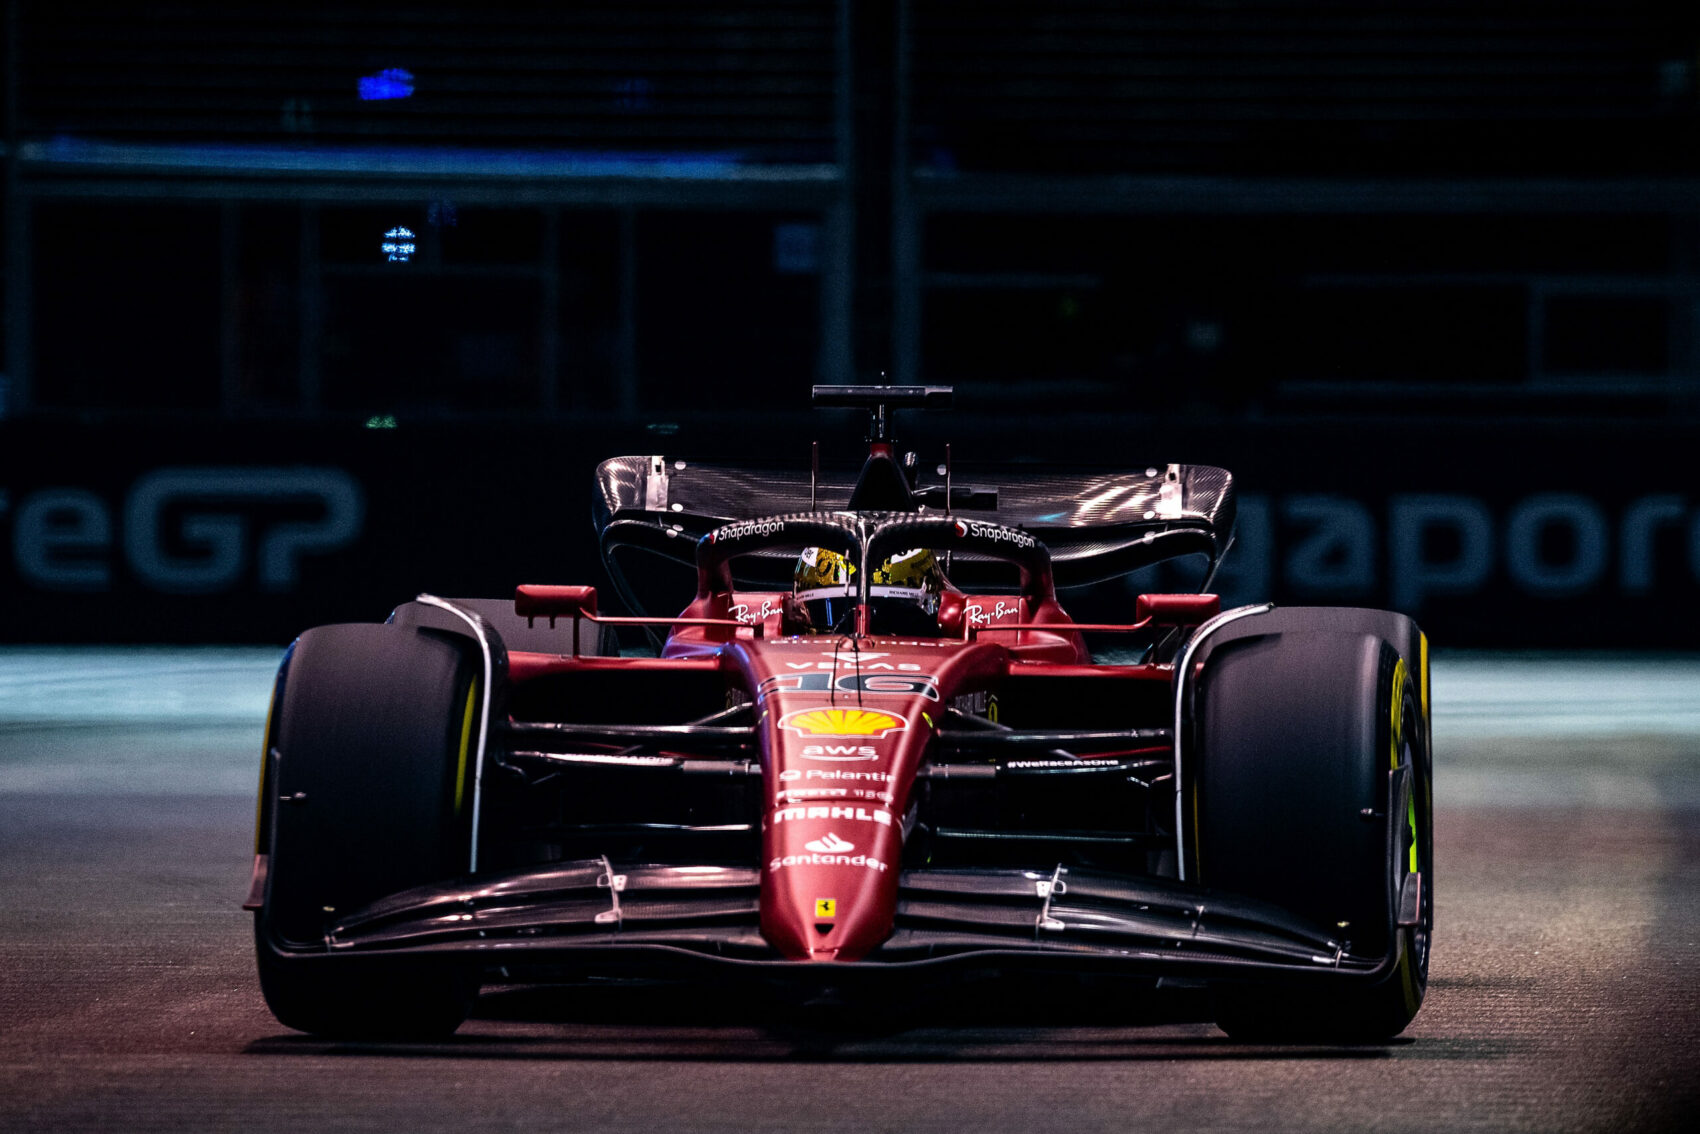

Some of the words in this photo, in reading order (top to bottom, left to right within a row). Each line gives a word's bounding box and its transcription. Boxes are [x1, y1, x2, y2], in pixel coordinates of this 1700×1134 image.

[0, 466, 366, 593] eGP
[719, 521, 785, 541] Snapdragon
[970, 523, 1036, 549] Snapdragon
[728, 600, 784, 625] Ray-Ban
[963, 602, 1018, 625] Ray-Ban
[786, 662, 921, 671] VELAS
[806, 769, 896, 783] Palantir
[774, 806, 892, 826] MAHLE
[769, 853, 888, 874] Santander
